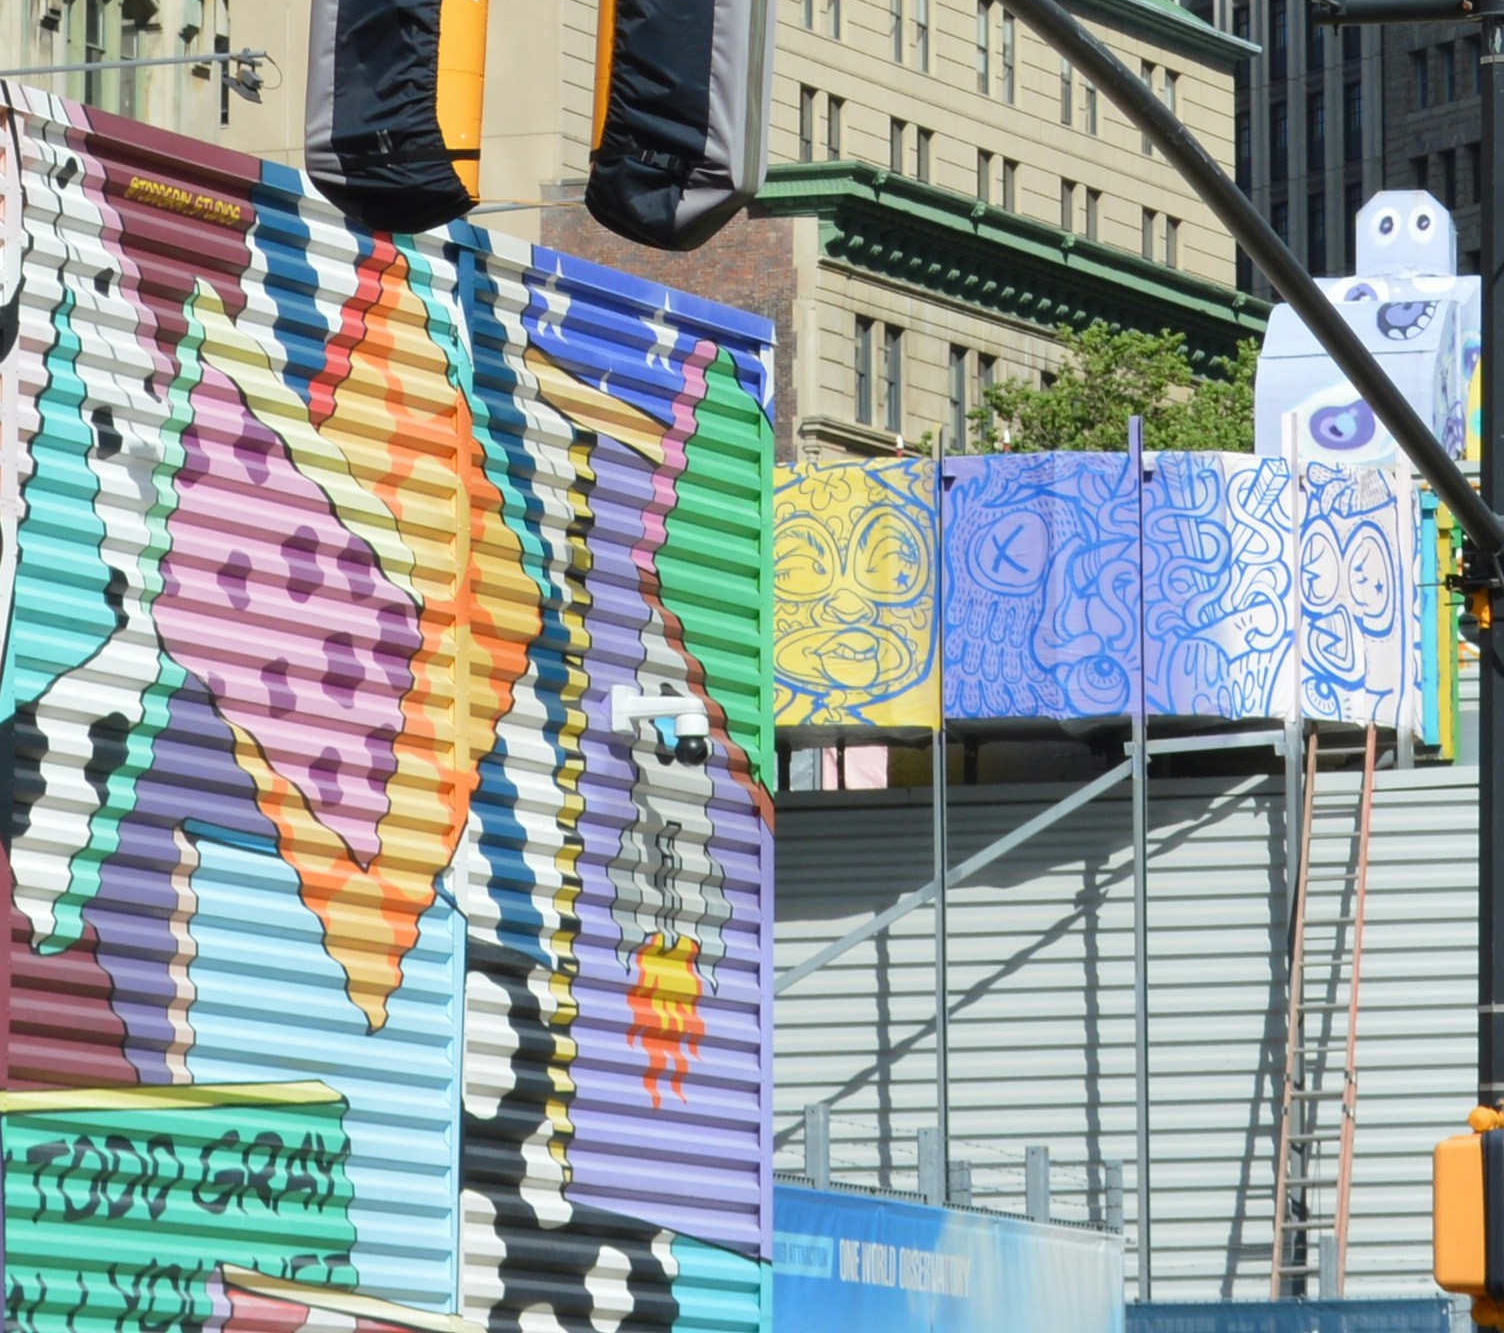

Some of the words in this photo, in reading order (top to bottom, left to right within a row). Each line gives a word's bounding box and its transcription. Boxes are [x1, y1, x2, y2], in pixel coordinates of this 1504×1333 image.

[26, 1134, 184, 1224] TODD
[192, 1129, 352, 1217] GRAY
[839, 1238, 861, 1283] ONE
[861, 1242, 896, 1288] WORLD
[899, 1247, 972, 1299] OBSERVATORY
